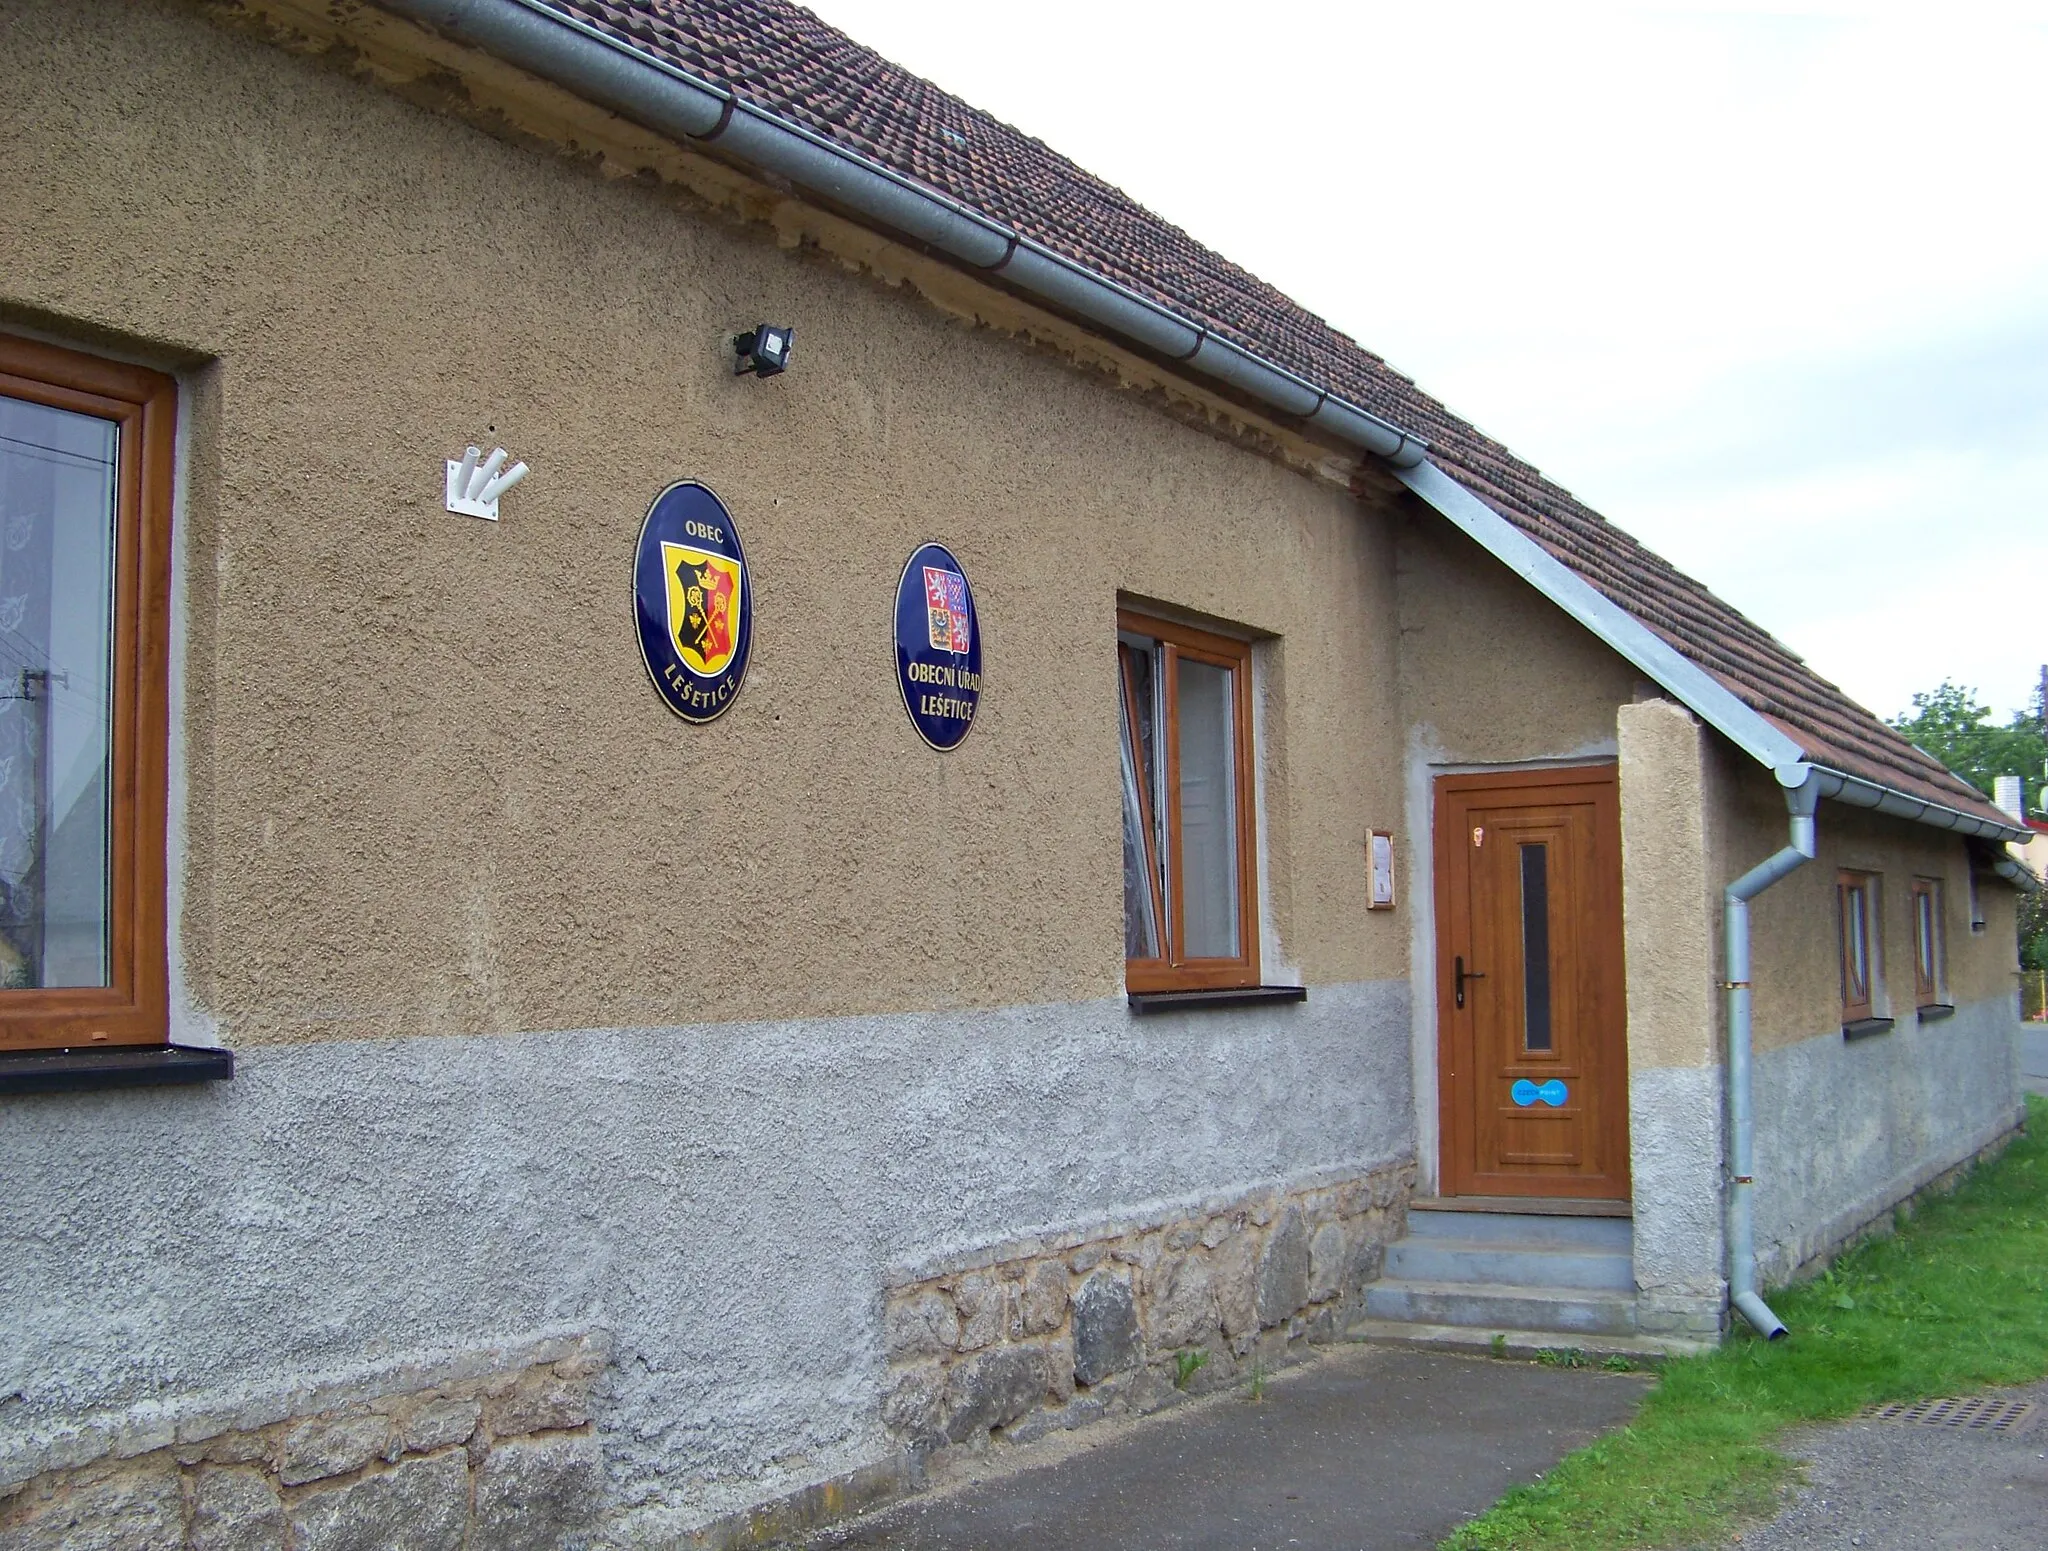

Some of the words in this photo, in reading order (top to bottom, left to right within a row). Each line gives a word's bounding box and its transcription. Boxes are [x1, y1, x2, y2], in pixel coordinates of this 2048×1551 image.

[685, 520, 724, 544] OBEC
[664, 663, 736, 709] LEŠETICE
[908, 662, 955, 687] OBECNÍ
[958, 665, 981, 692] ÚŘAD
[920, 692, 973, 721] LEŠETICE
